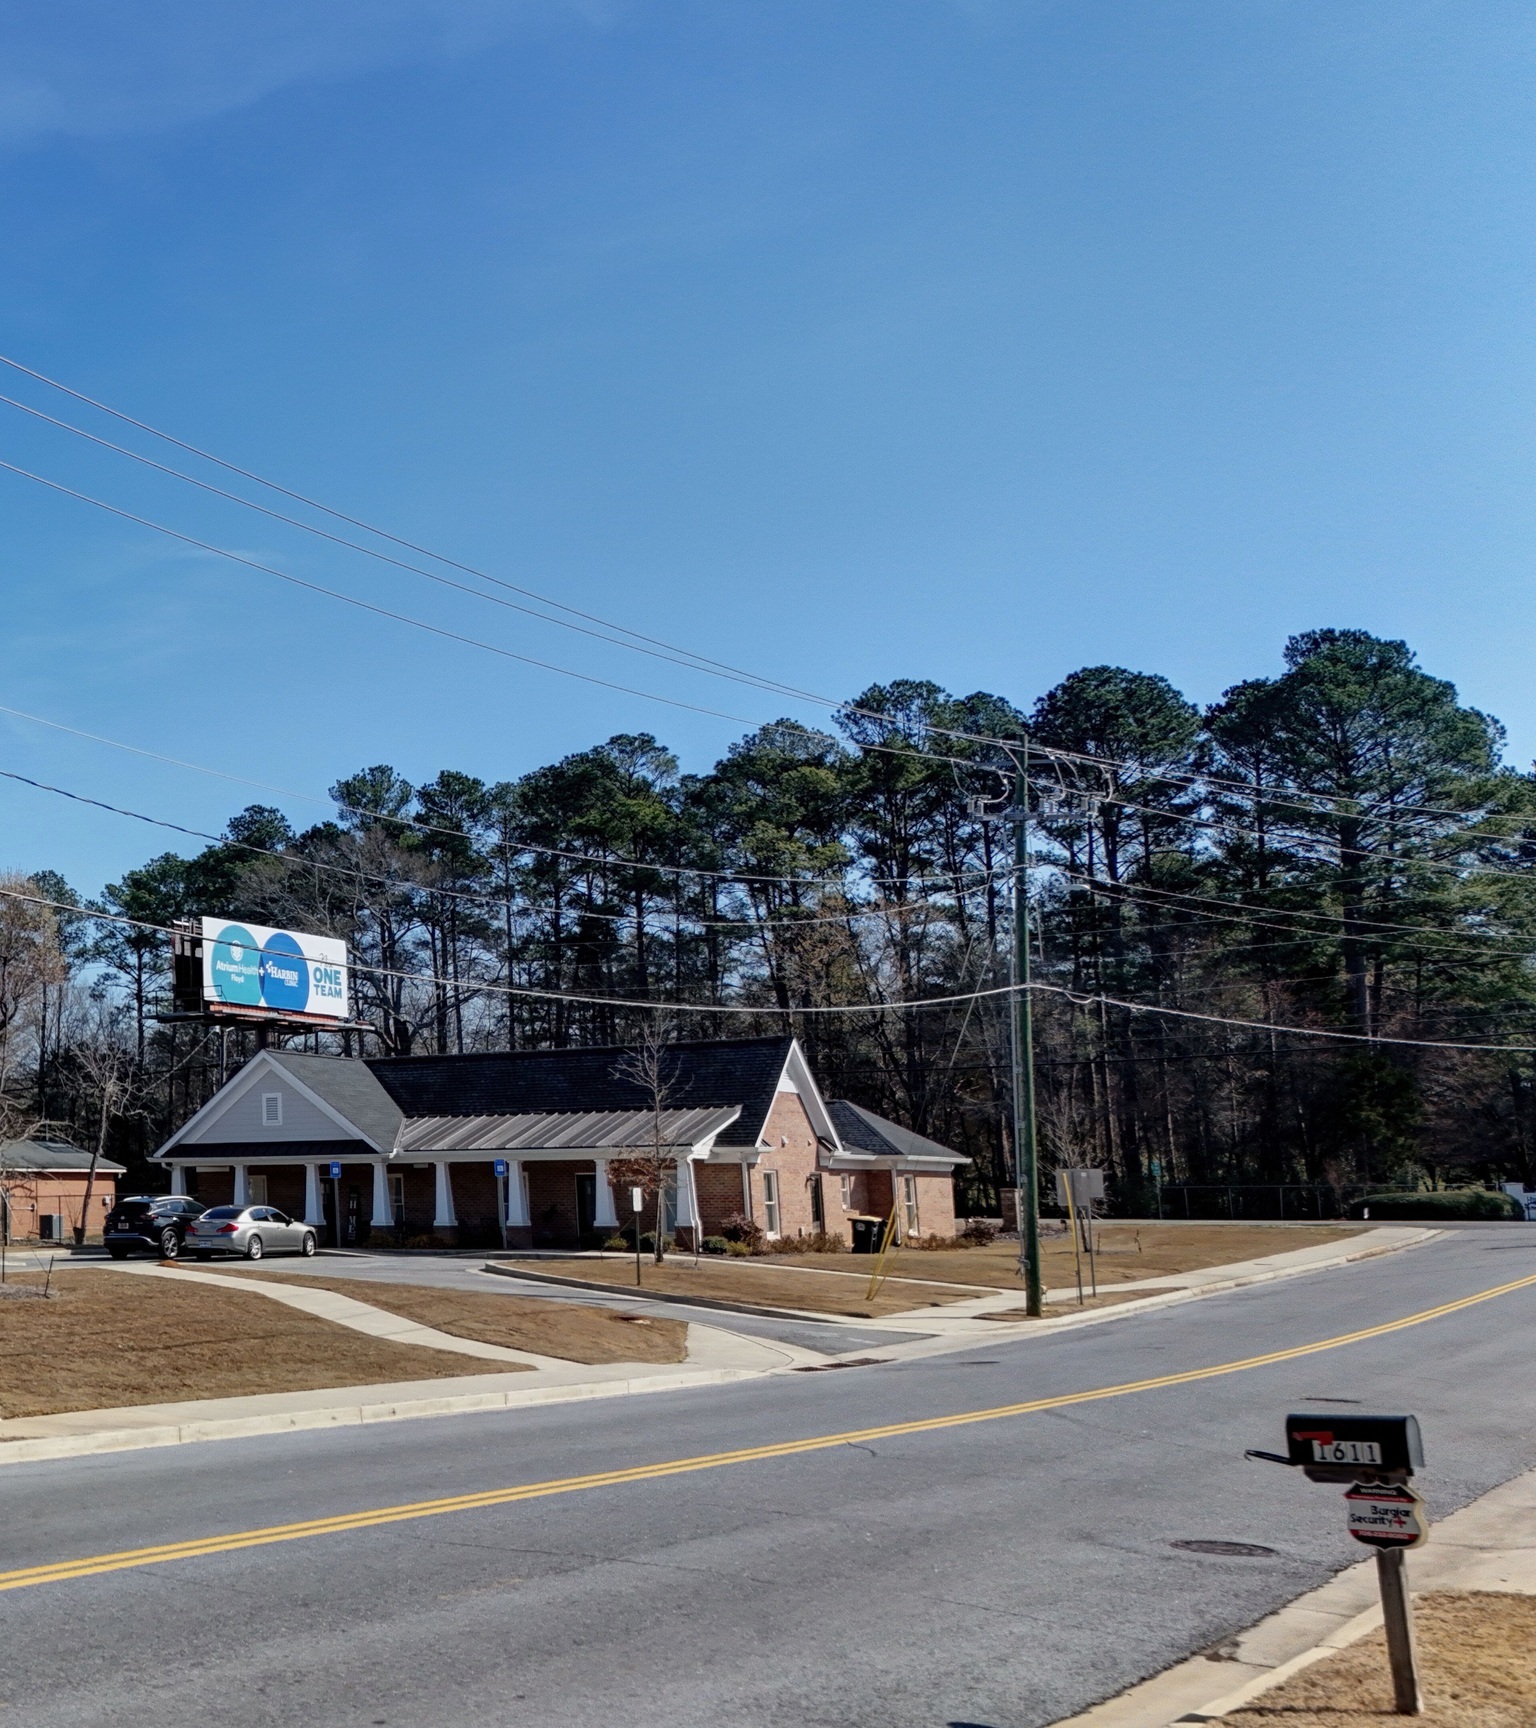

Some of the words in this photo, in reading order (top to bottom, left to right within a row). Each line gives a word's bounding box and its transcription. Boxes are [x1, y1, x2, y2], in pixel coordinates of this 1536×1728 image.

[271, 966, 298, 980] HARBIN
[313, 967, 342, 986] ONE
[313, 984, 342, 999] TEAM
[1319, 1442, 1377, 1462] 1611
